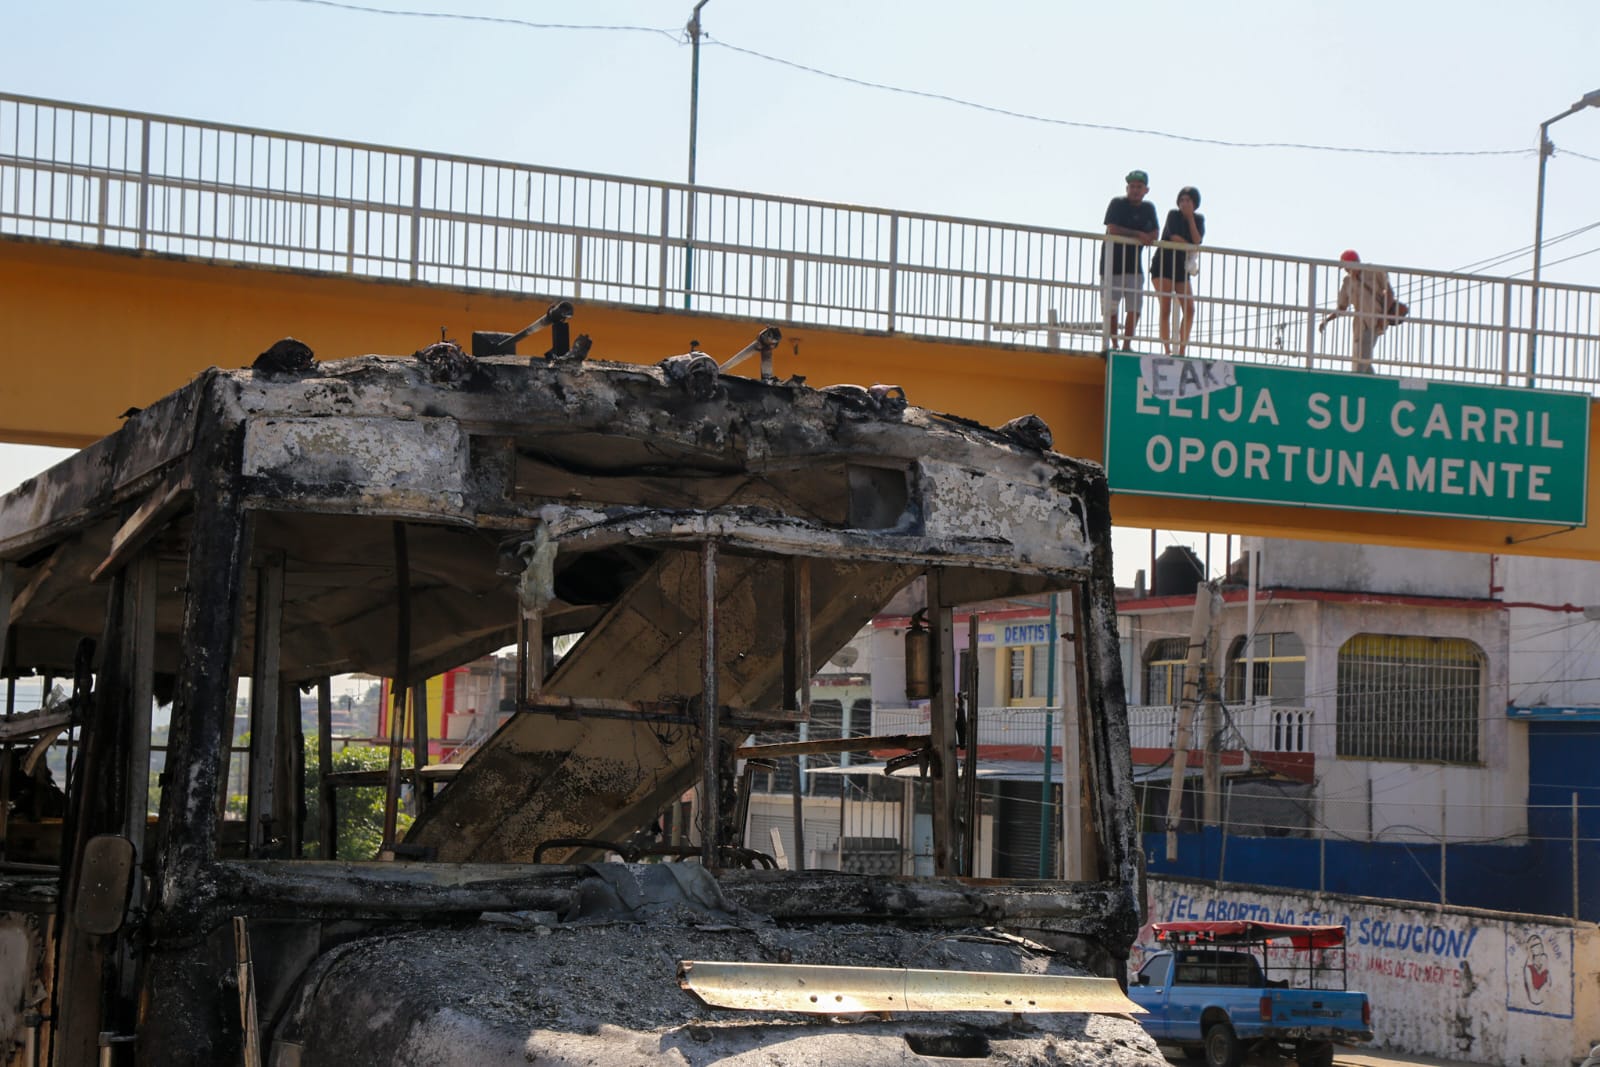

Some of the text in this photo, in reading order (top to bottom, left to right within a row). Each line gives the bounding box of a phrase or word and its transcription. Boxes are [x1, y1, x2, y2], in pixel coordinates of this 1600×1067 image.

[1307, 392, 1366, 433] SU
[1390, 400, 1564, 449] CARRIL
[1145, 434, 1552, 501] OPORTUNAMENTE
[1004, 623, 1058, 643] DENTIST
[1204, 899, 1270, 923] ABORTO
[1274, 908, 1295, 926] NO
